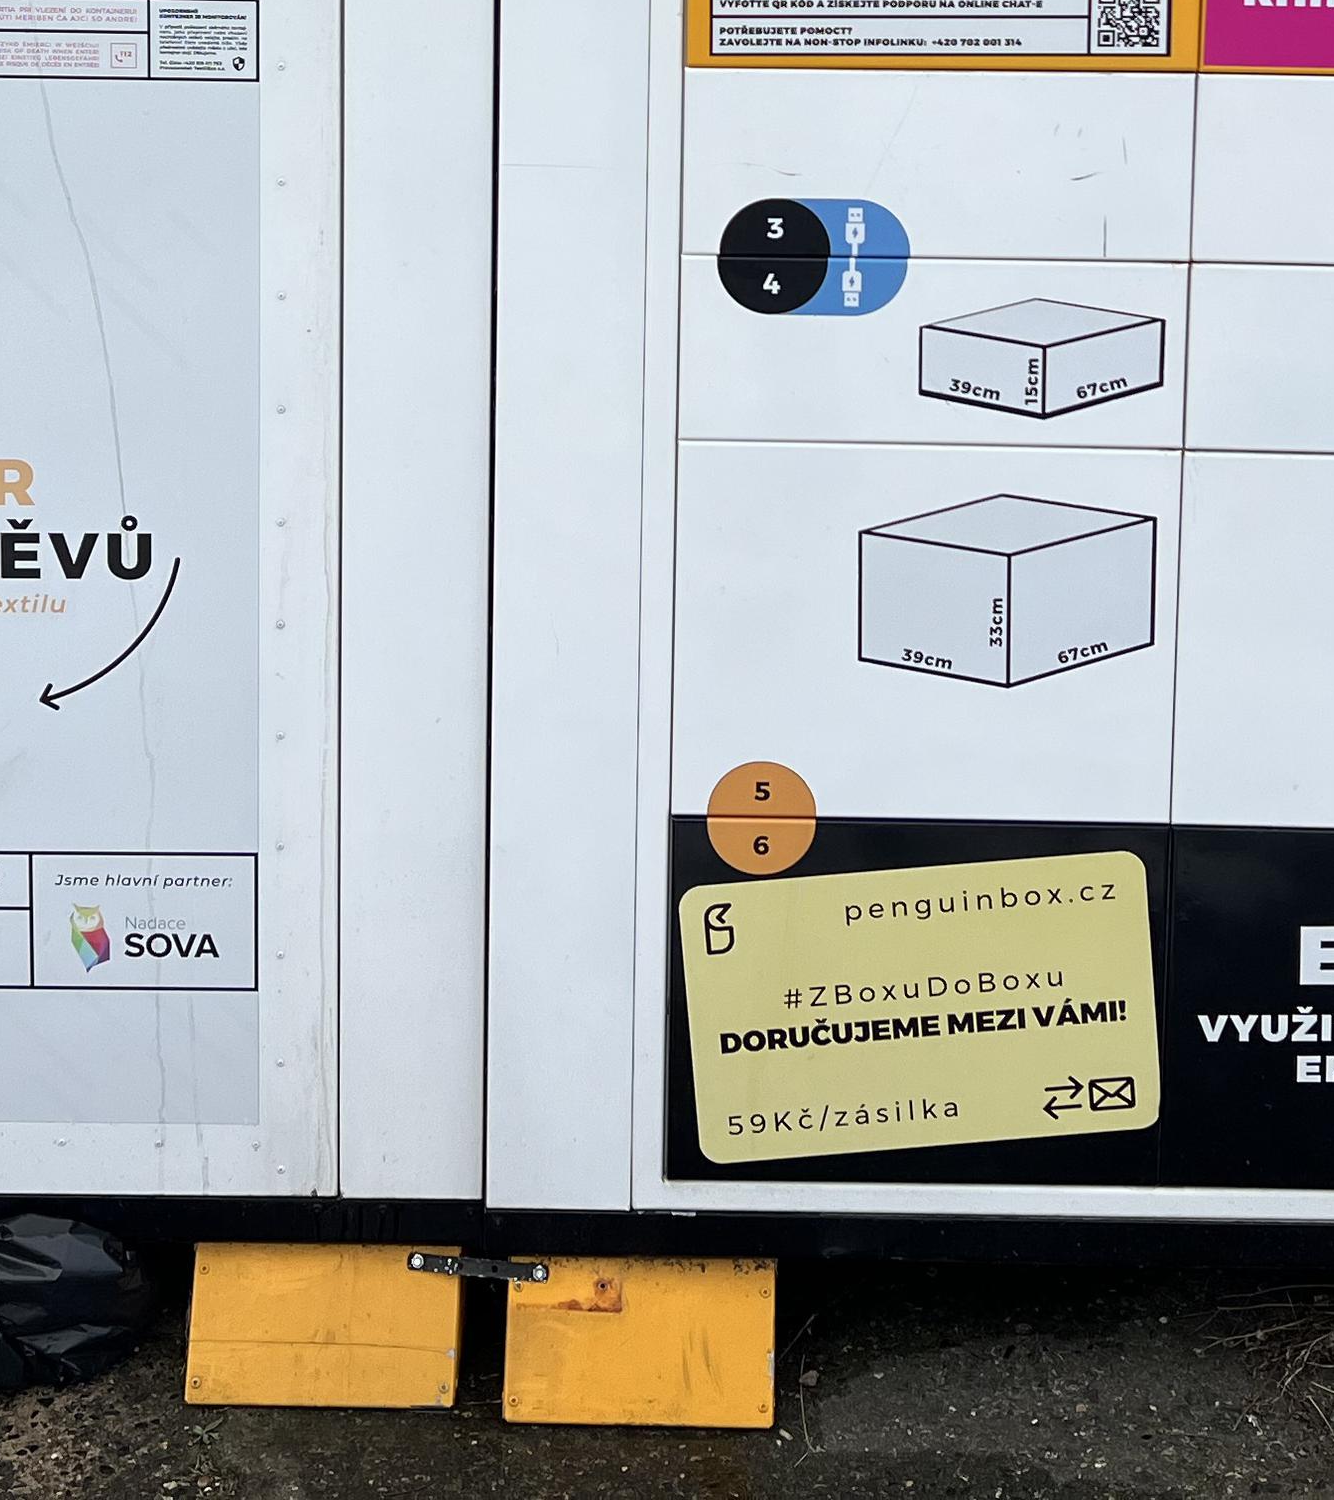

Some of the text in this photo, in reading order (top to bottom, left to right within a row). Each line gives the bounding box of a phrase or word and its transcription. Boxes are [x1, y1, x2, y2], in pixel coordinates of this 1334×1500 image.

[719, 0, 769, 8] VYFOŤTE
[772, 0, 788, 10] QR
[817, 0, 825, 8] A
[882, 0, 937, 8] PODPORU
[939, 0, 955, 8] NA
[958, 0, 1000, 8] ONLINE
[719, 25, 853, 35] POTŘEBUJETE POMOCT?
[719, 38, 783, 47] ZAVOLEJTE
[785, 38, 801, 47] NA
[804, 38, 862, 47] NON-STOP
[864, 38, 927, 47] INFOLINKU:
[767, 218, 783, 238] 3
[763, 273, 780, 294] 4
[949, 358, 1128, 406] 39cm 15cm 67cm
[901, 599, 1109, 670] 39cm 33cm 67cm
[755, 782, 770, 801] 5
[754, 836, 769, 855] 6
[54, 874, 233, 889] Jsme hlavní partner:
[846, 885, 1115, 926] penguinbox.cz
[125, 916, 186, 930] Nadace
[125, 933, 219, 957] SOVA
[784, 971, 1062, 1009] #ZBoxuDoBoxu
[720, 998, 1126, 1054] DORUČUJEME MEZI VÁMI!
[729, 1099, 958, 1135] 59Kč/zásilka
